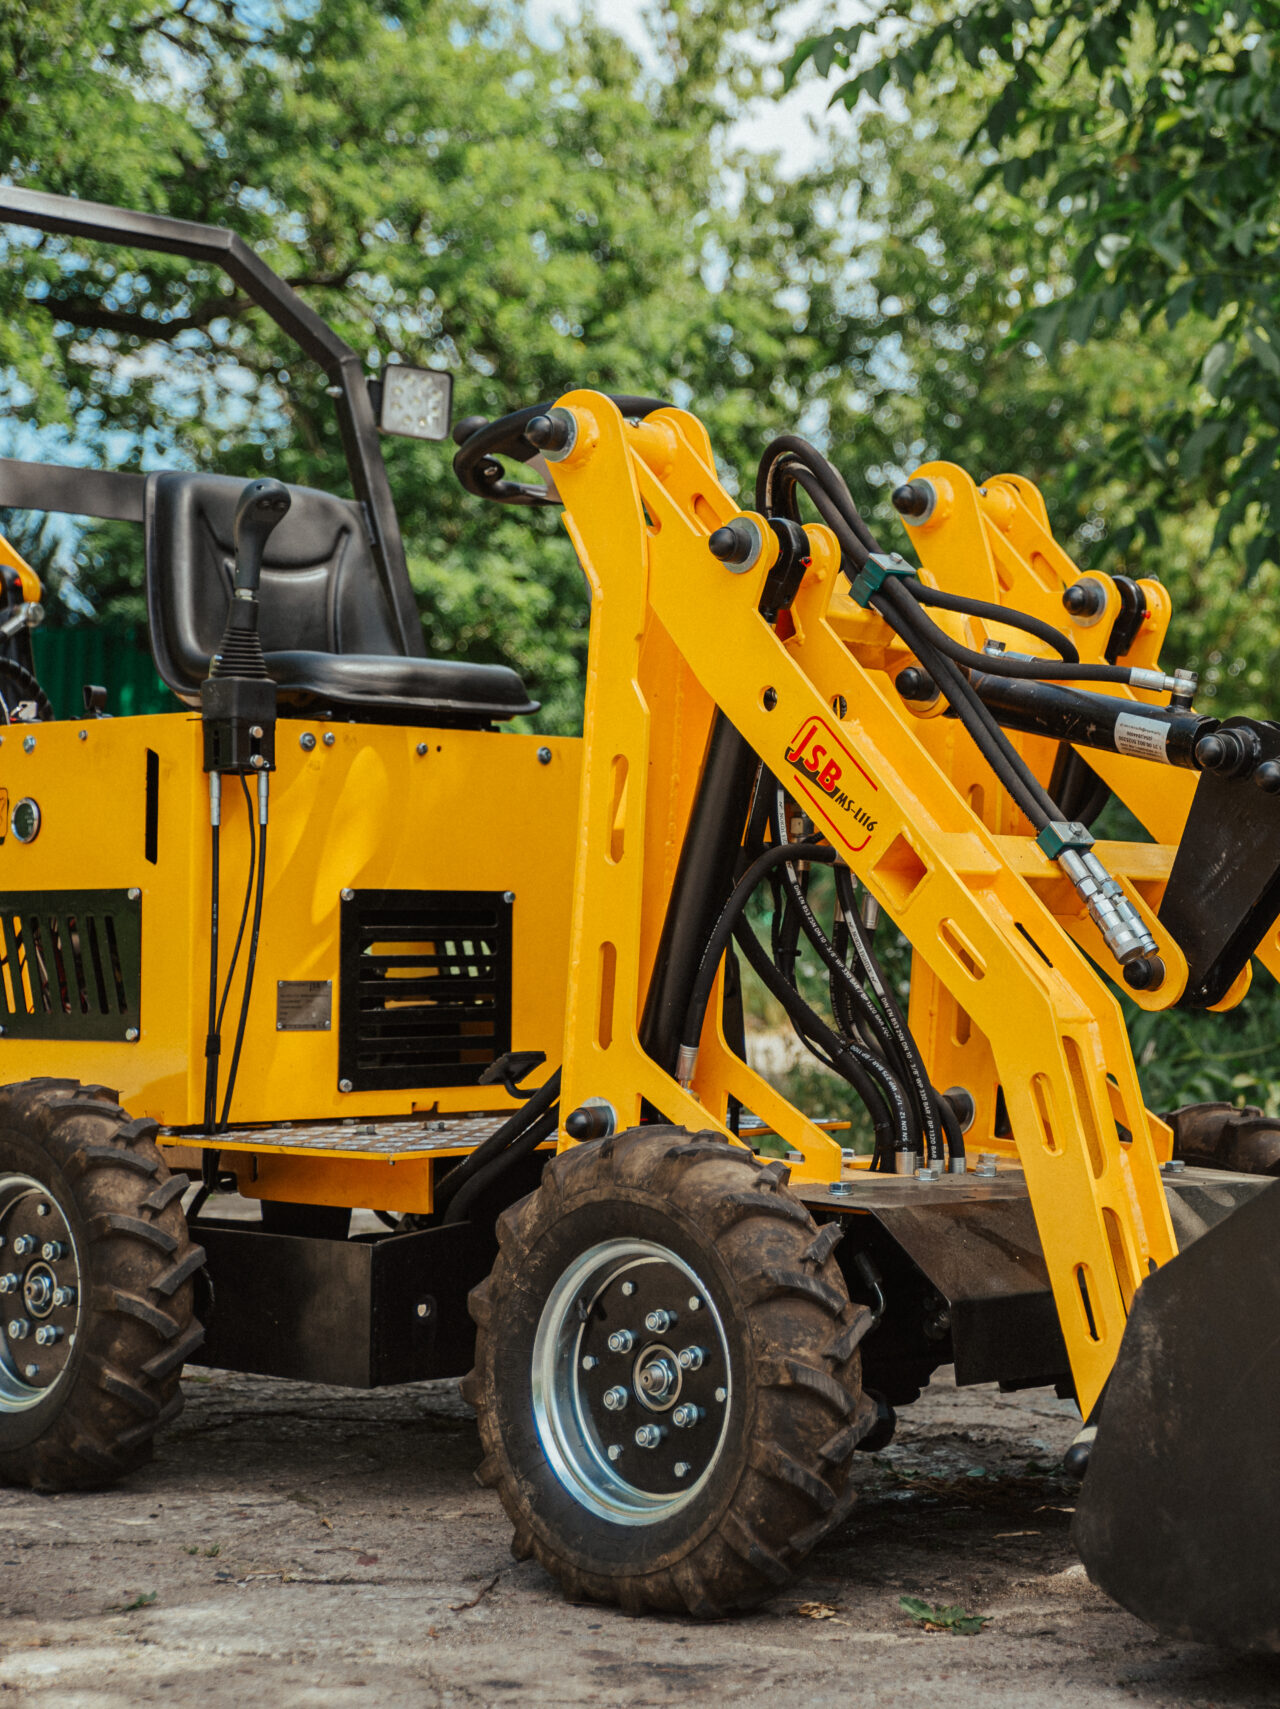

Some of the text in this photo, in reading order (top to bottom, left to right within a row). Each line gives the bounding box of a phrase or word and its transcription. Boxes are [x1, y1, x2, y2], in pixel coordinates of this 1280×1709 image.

[787, 725, 878, 832] JSB MS-L116
[798, 896, 805, 904] EN
[802, 905, 810, 916] 853
[814, 927, 822, 936] DN
[826, 947, 838, 958] 3/8"
[835, 958, 844, 968] WP
[842, 968, 852, 978] 330
[849, 977, 861, 989] BAR
[860, 992, 869, 1001] BP
[866, 1001, 877, 1014] 1320
[874, 1014, 884, 1026] BAR
[872, 1060, 884, 1071] BAR
[881, 997, 890, 1008] DIN
[886, 1008, 894, 1017] EN
[890, 1017, 900, 1028] 853
[901, 1041, 909, 1051] DN
[910, 1064, 920, 1077] 3/8"
[916, 1077, 924, 1088] WP
[923, 1101, 931, 1114] BAR
[927, 1120, 934, 1129] BP
[882, 1070, 893, 1080] 275
[888, 1081, 898, 1092] WP
[894, 1092, 903, 1106] 1/2"
[900, 1111, 906, 1119] 12
[901, 1120, 907, 1131] DN
